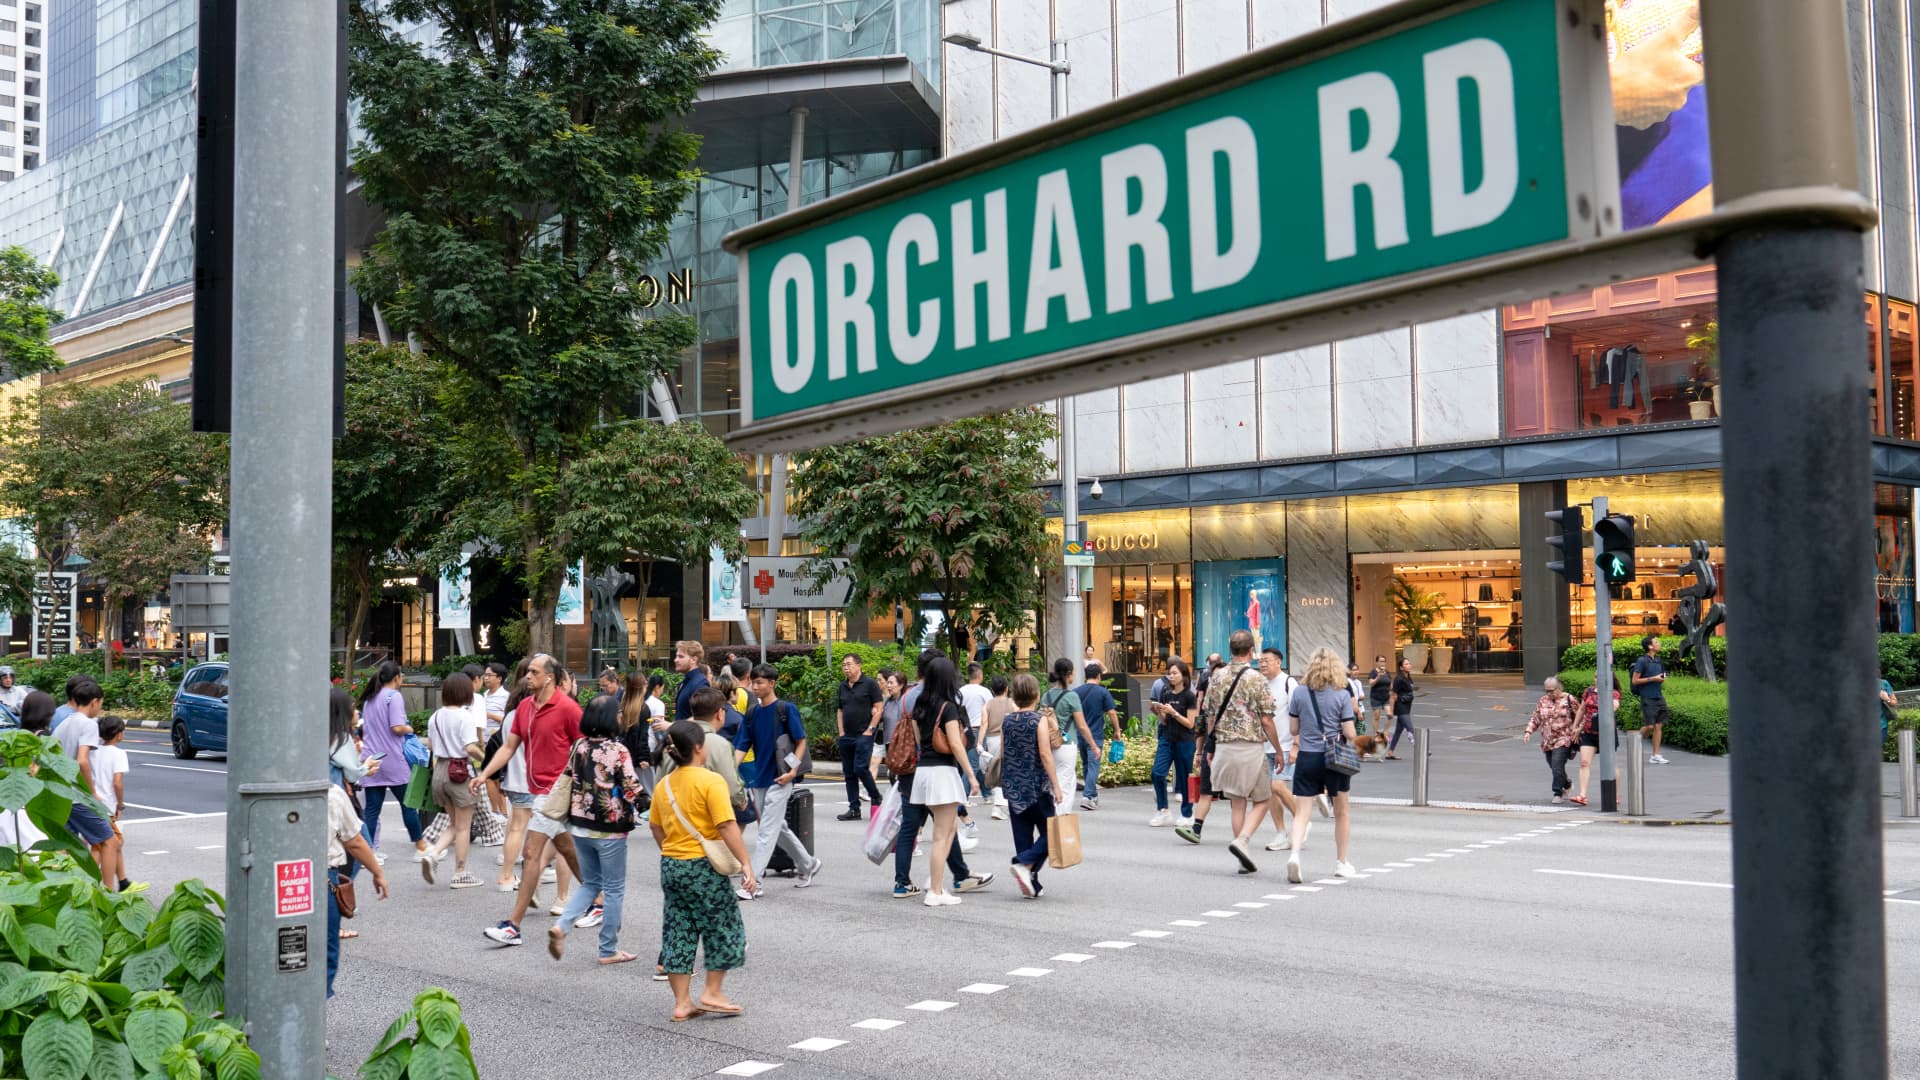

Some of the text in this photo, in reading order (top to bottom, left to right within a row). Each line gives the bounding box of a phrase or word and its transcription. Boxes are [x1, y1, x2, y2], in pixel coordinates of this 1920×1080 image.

[770, 39, 1518, 393] ORCHARD RD
[1095, 532, 1159, 552] GUCCI
[1301, 596, 1334, 607] GUCCI
